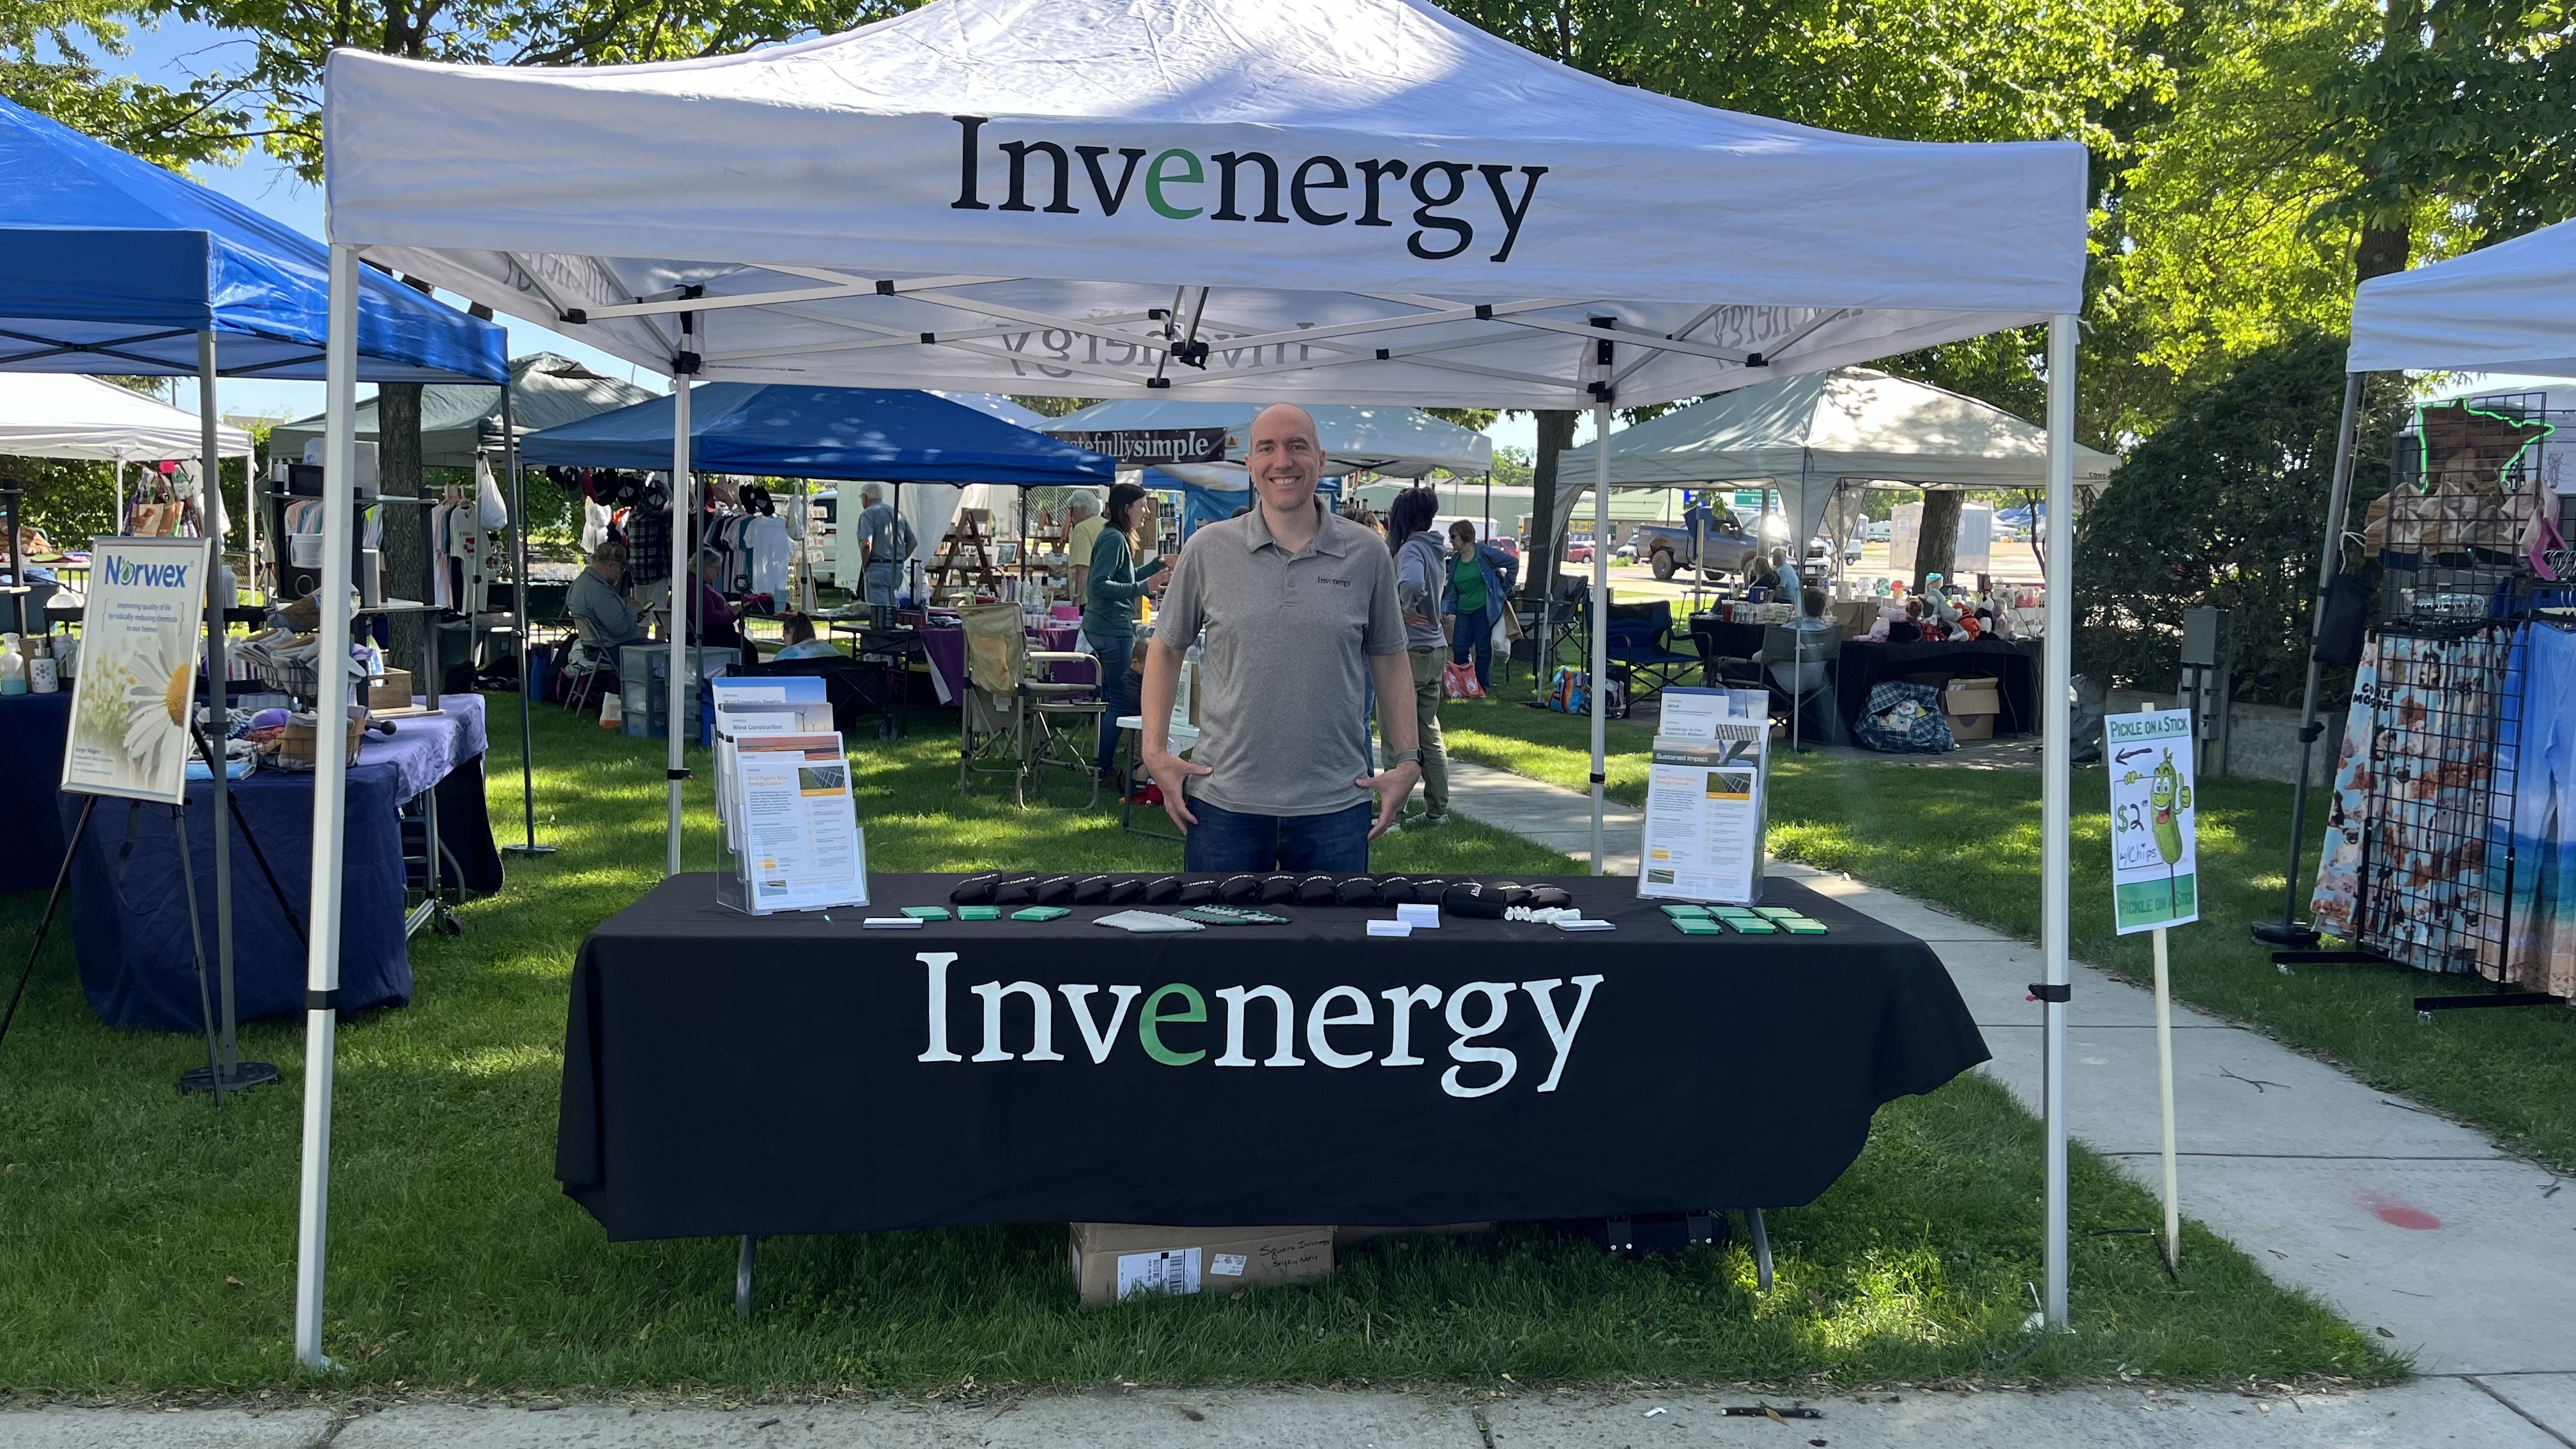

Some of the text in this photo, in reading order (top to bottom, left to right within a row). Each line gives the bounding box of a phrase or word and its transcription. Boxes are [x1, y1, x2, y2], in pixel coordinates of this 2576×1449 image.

[951, 115, 1549, 263] Invenergy
[105, 555, 188, 588] Norwex
[1317, 576, 1351, 587] Invenergy
[142, 602, 158, 611] quality
[114, 613, 134, 622] radically
[135, 614, 155, 623] reducing
[157, 615, 177, 623] chemicals
[2110, 716, 2188, 737] PICKLE ON A STICK
[1656, 753, 1686, 761] Sustained
[2120, 843, 2156, 866] w/Chips
[916, 951, 1604, 1098] Invenergy
